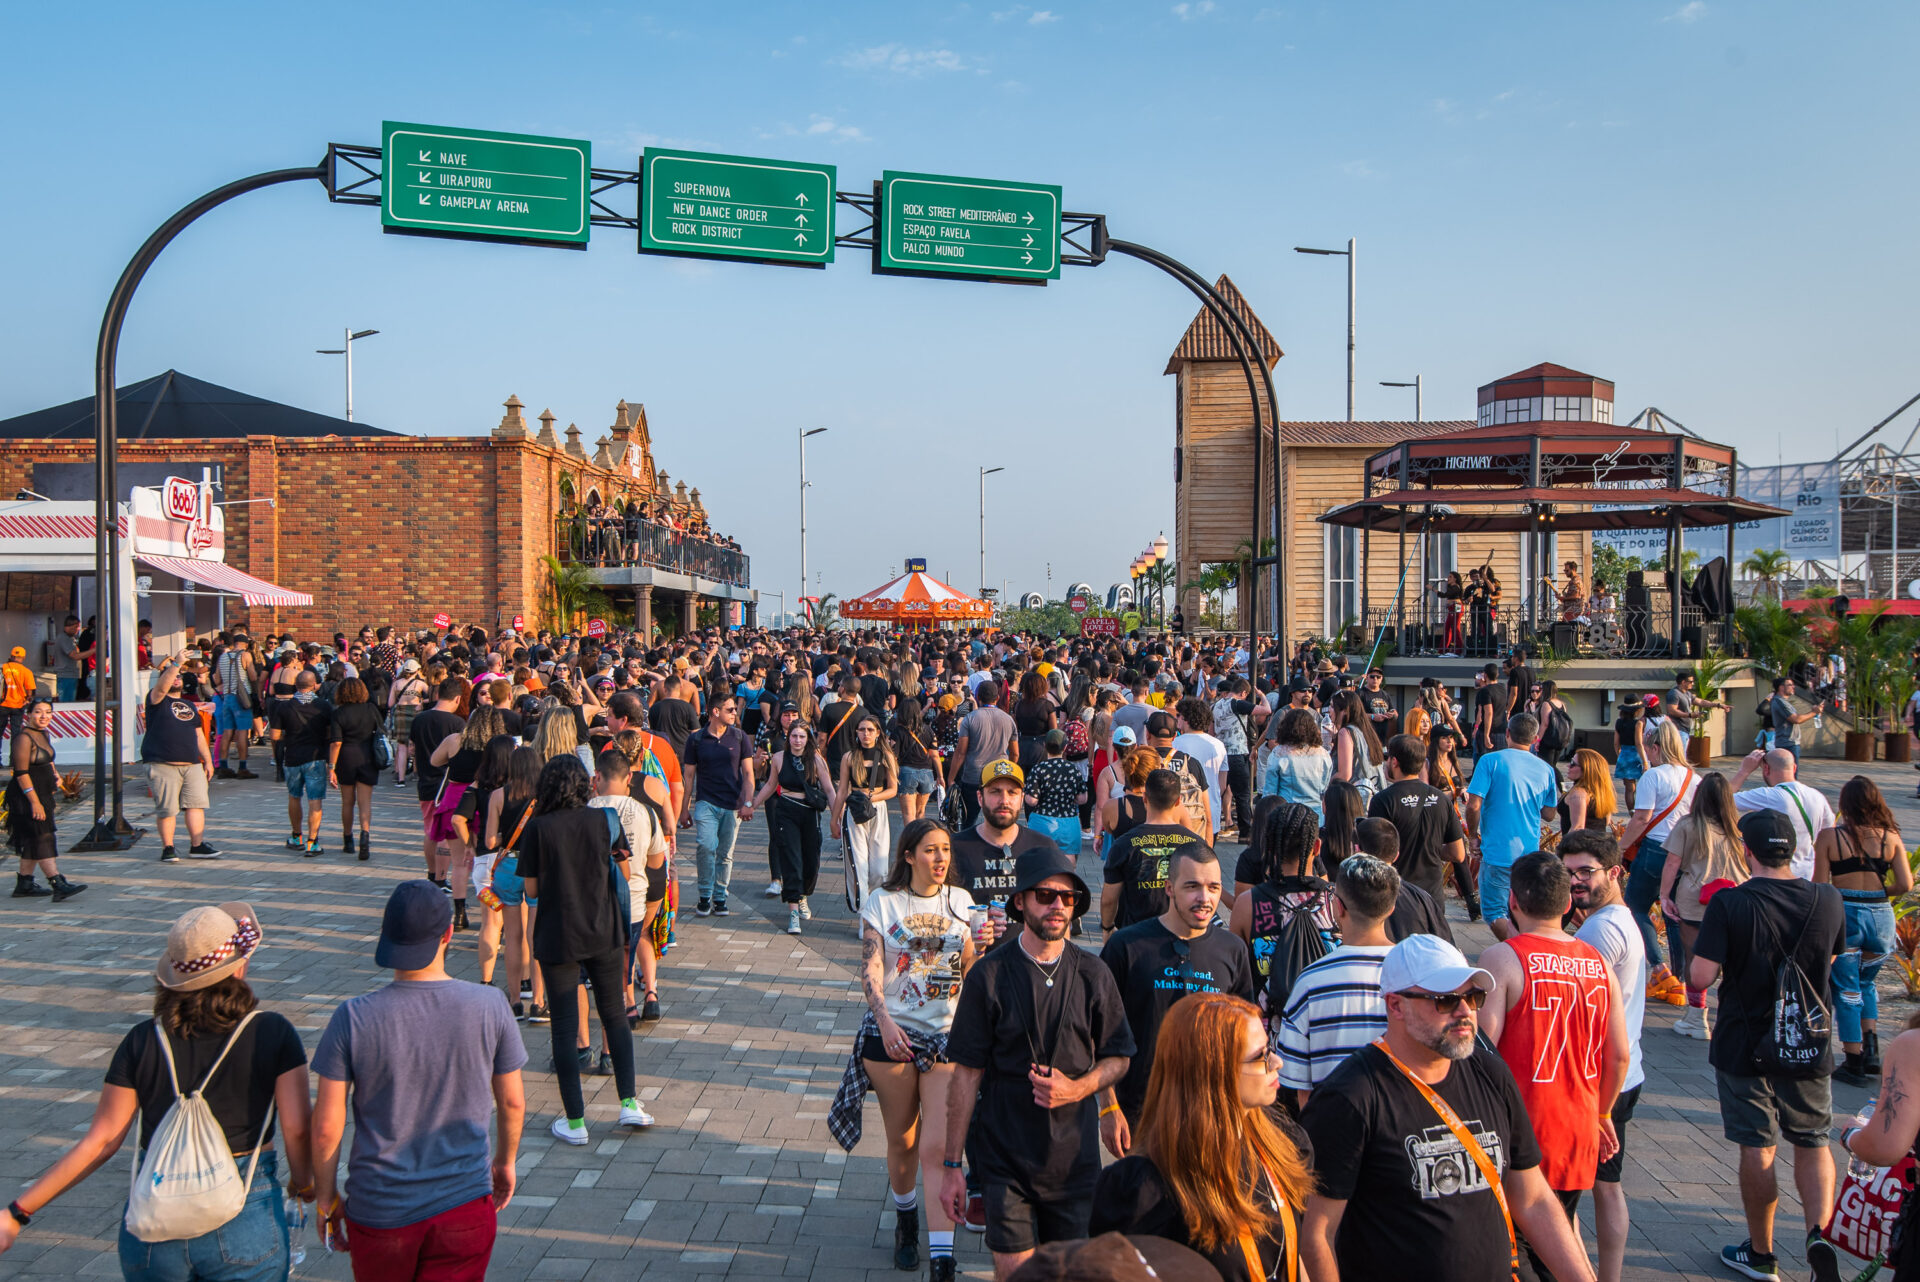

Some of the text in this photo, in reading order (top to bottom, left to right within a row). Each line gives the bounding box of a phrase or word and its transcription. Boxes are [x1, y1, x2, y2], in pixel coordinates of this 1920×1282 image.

[440, 152, 467, 166] NAVE
[440, 174, 492, 189] UIRAPURU
[674, 182, 731, 198] SUPERNOVA
[440, 195, 529, 214] GAMEPLAY ARENA
[673, 203, 768, 222] NEW DANCE ORDER
[903, 204, 1017, 224] ROCK STREET MEDITERRÂNEO
[672, 223, 743, 239] ROCK DISTRICT
[903, 224, 971, 240] ESPAÇO FAVELA
[903, 243, 965, 257] PALCO MUNDO
[1446, 456, 1493, 469] HIGHWAY
[173, 486, 196, 514] Bob's
[1797, 495, 1822, 506] Rio
[1794, 519, 1826, 527] LEGADO
[1606, 528, 1649, 539] QUATRO
[1630, 540, 1645, 549] DO
[588, 627, 605, 635] CAIXA
[1589, 621, 1620, 649] 85
[1131, 834, 1157, 847] IRON
[1528, 953, 1607, 979] STARTER
[1164, 967, 1215, 981] Go head.
[1154, 980, 1184, 990] Make
[1186, 983, 1201, 993] my
[1532, 979, 1608, 1083] 71
[1796, 1047, 1819, 1060] RIO
